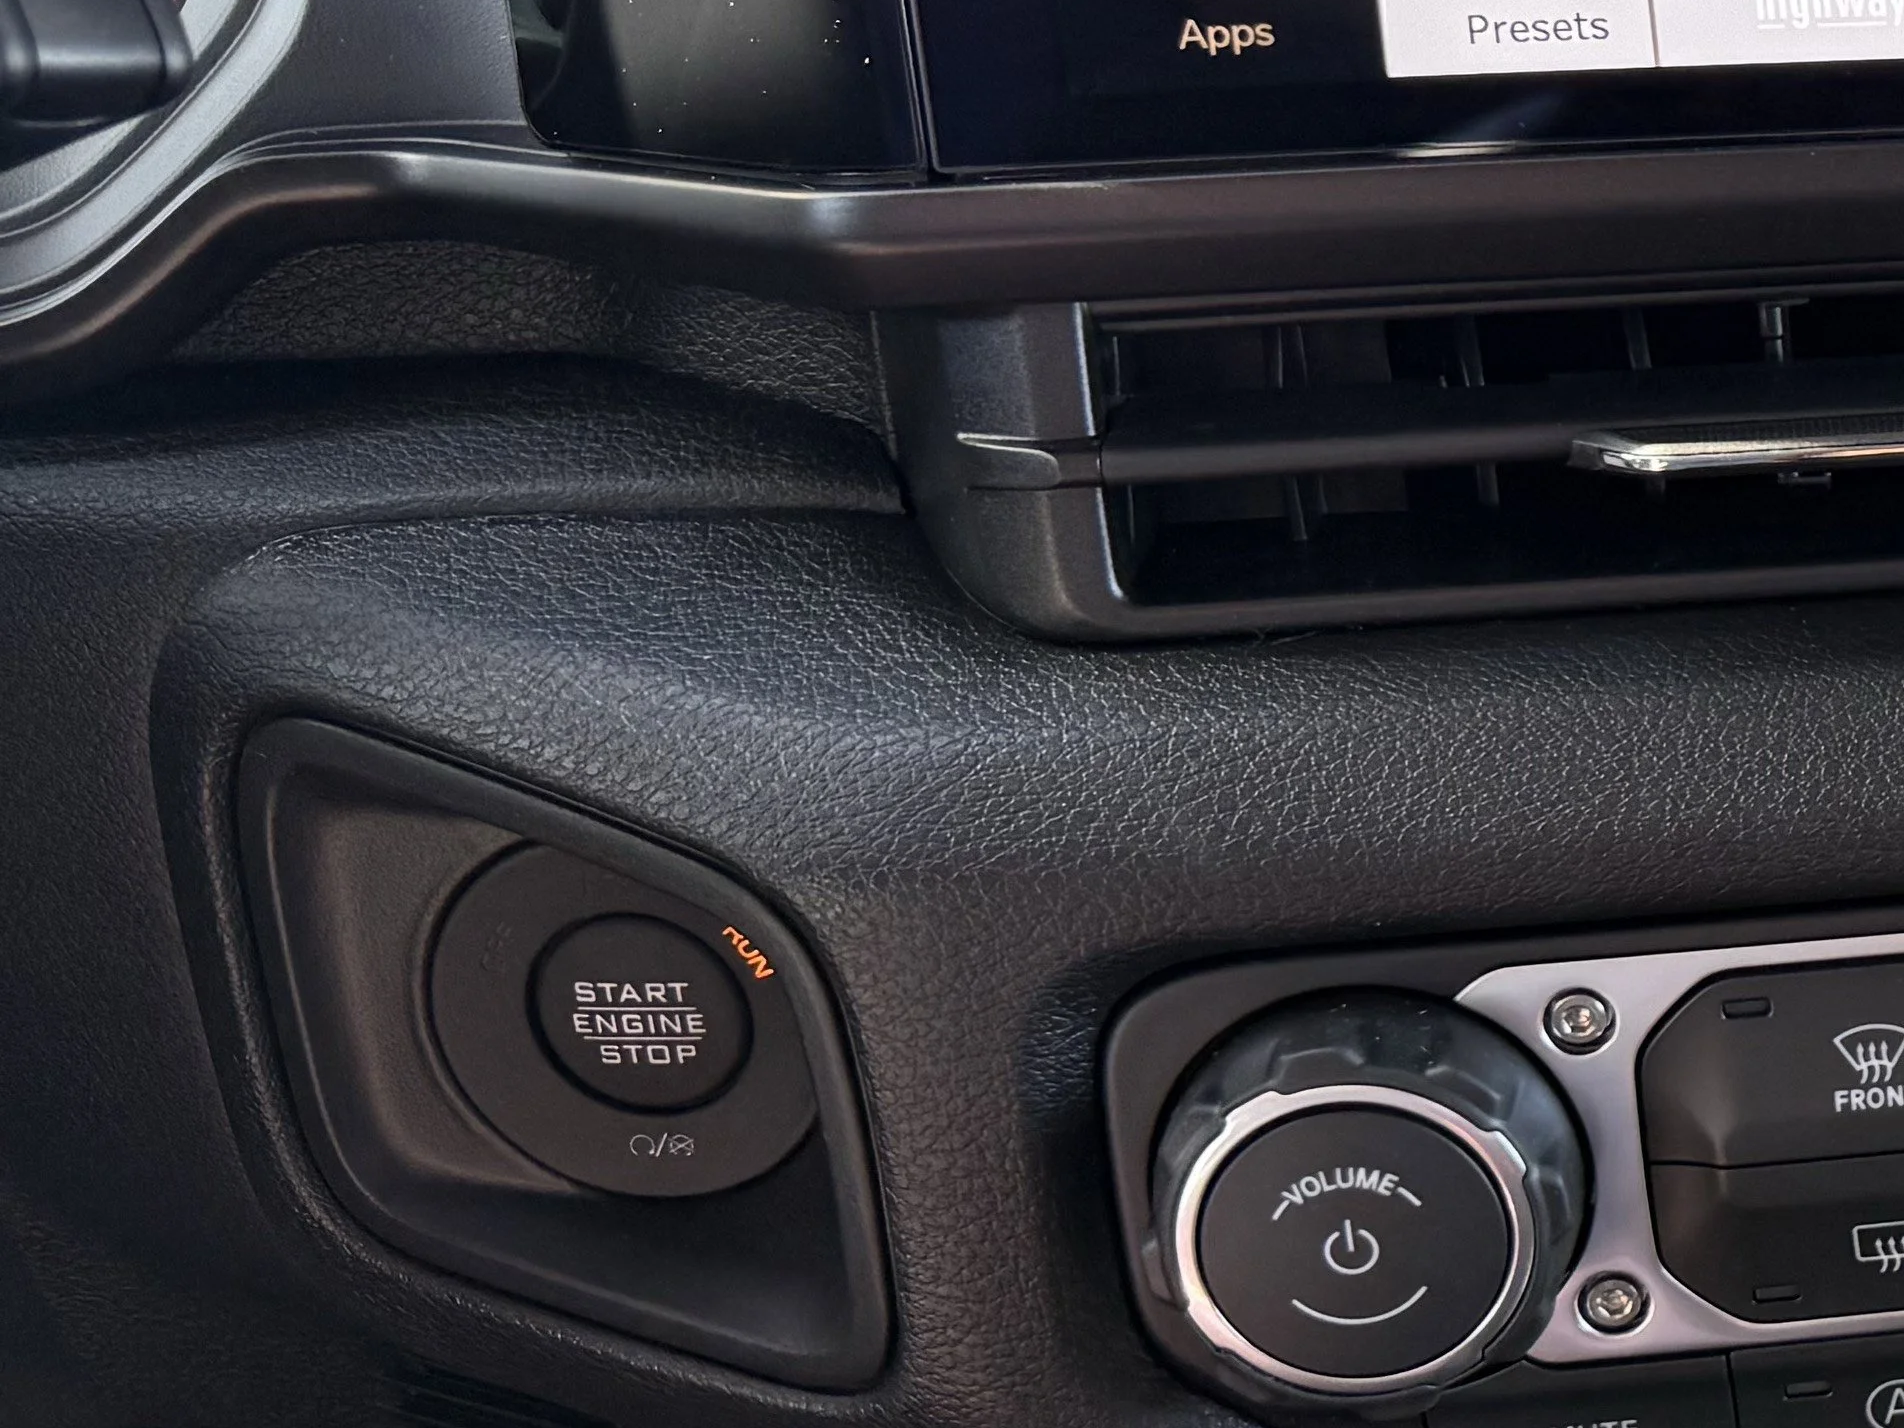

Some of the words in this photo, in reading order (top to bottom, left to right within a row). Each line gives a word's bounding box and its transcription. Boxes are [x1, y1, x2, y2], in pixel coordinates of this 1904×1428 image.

[1179, 17, 1276, 55] Apps
[1467, 10, 1611, 46] Presets
[721, 925, 774, 980] RUN
[574, 981, 689, 1004] START
[573, 1012, 706, 1035] ENGINE
[600, 1043, 697, 1065] STOP
[1283, 1165, 1400, 1204] VOLUME
